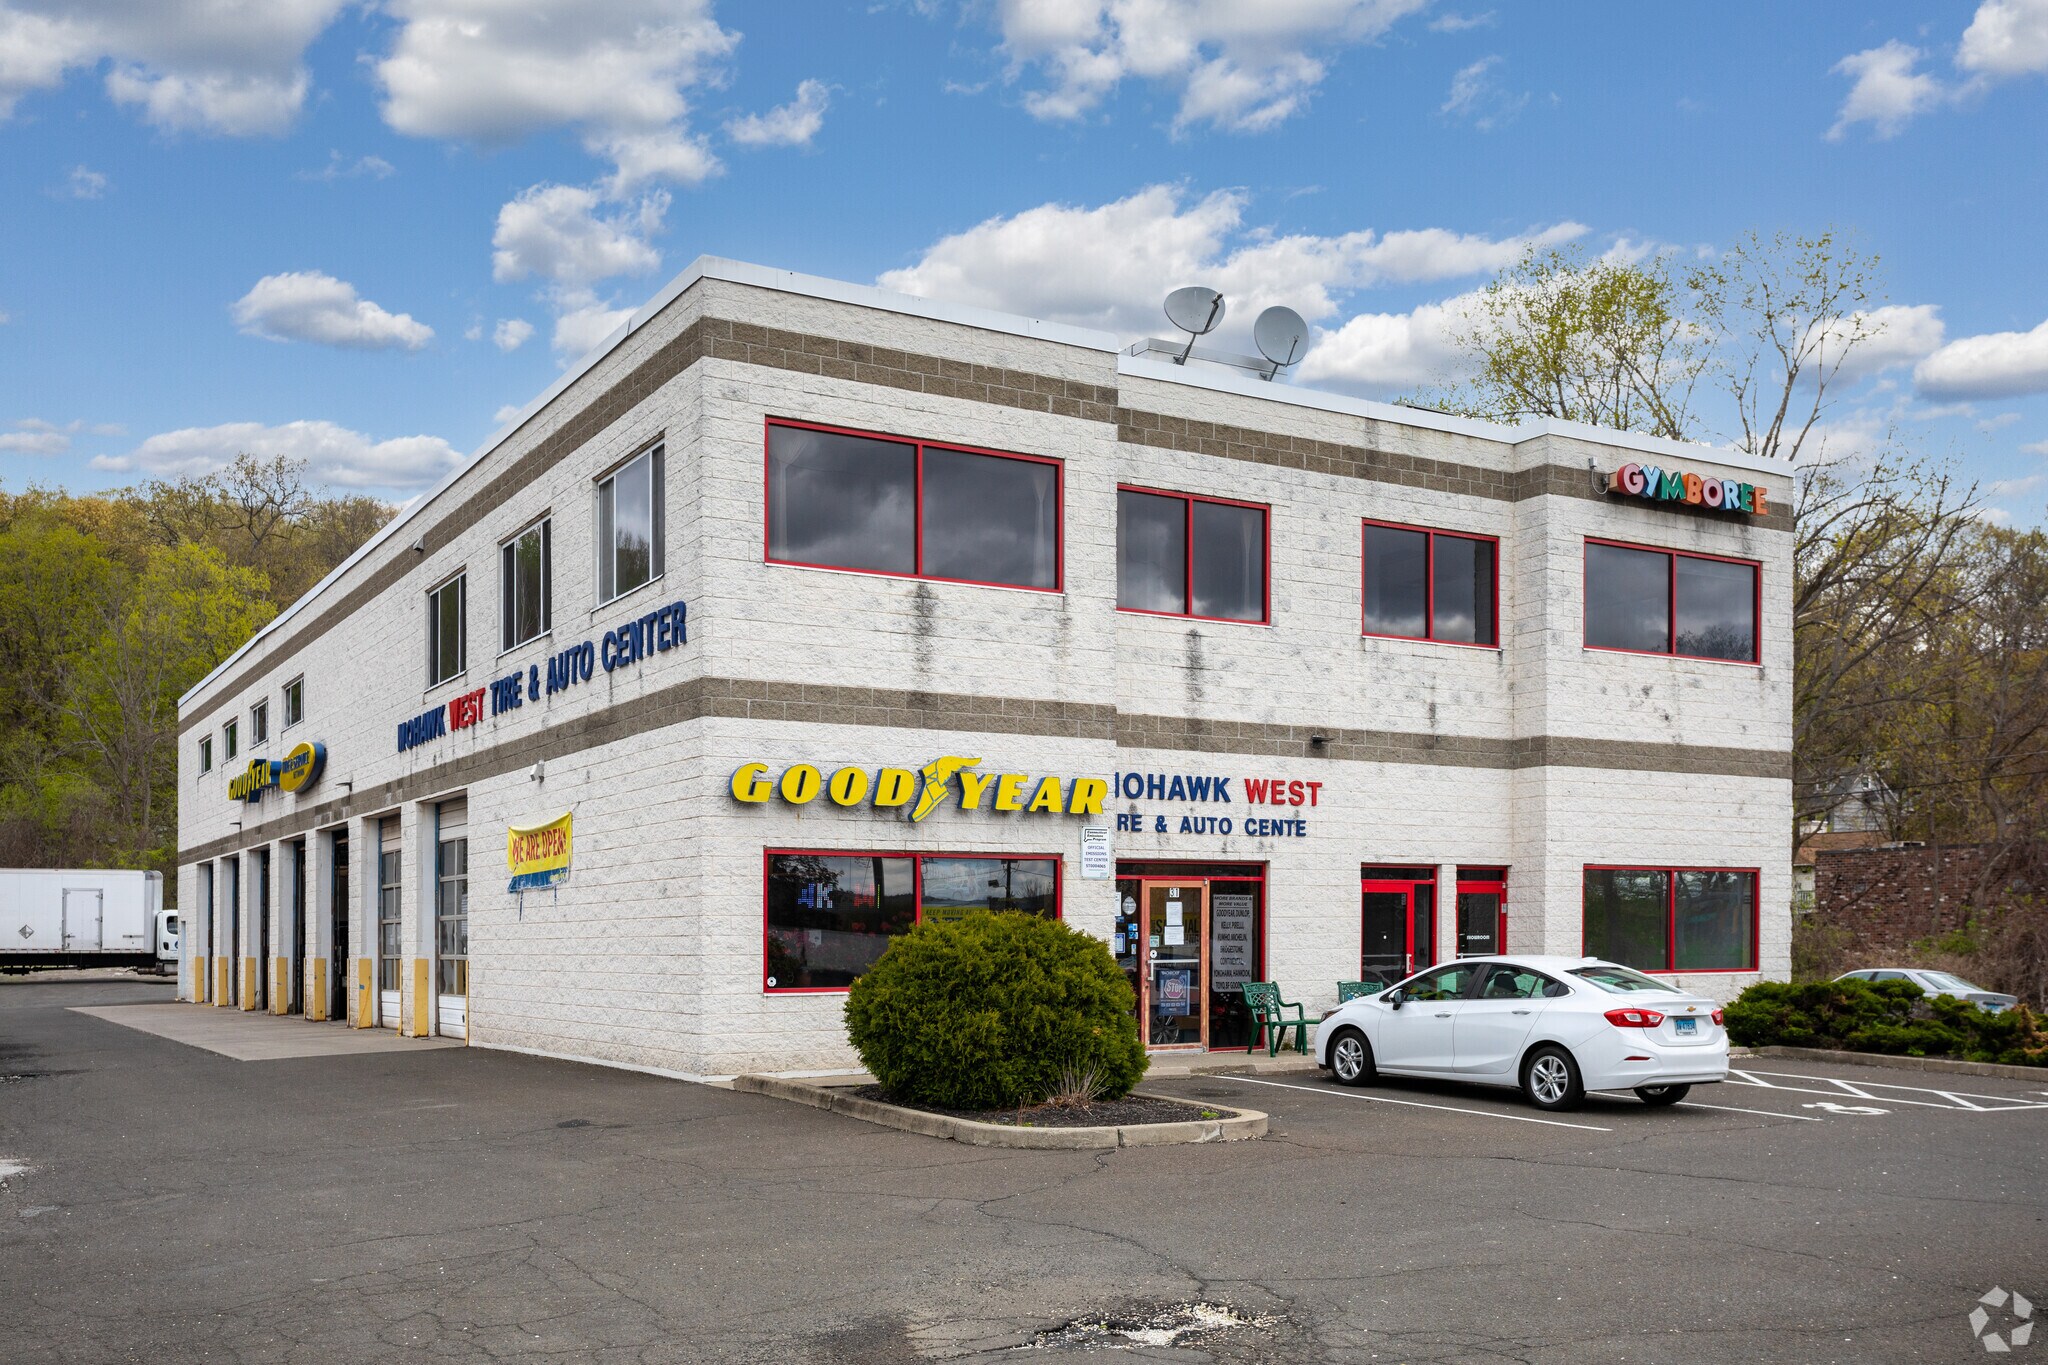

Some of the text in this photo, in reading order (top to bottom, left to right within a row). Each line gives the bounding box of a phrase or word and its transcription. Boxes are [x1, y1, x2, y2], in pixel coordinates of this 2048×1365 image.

[1618, 463, 1768, 515] GYMBOREE
[397, 600, 687, 753] MOHAWK WEST TIRE & AUTO CENTER
[1115, 772, 1323, 807] OHAWK WEST
[1155, 815, 1168, 833] &
[1180, 816, 1233, 835] AUTO
[1245, 818, 1307, 837] CENTE
[513, 827, 567, 863] WE ARE OPEN!
[1170, 888, 1179, 897] 31
[1166, 981, 1183, 993] STOP
